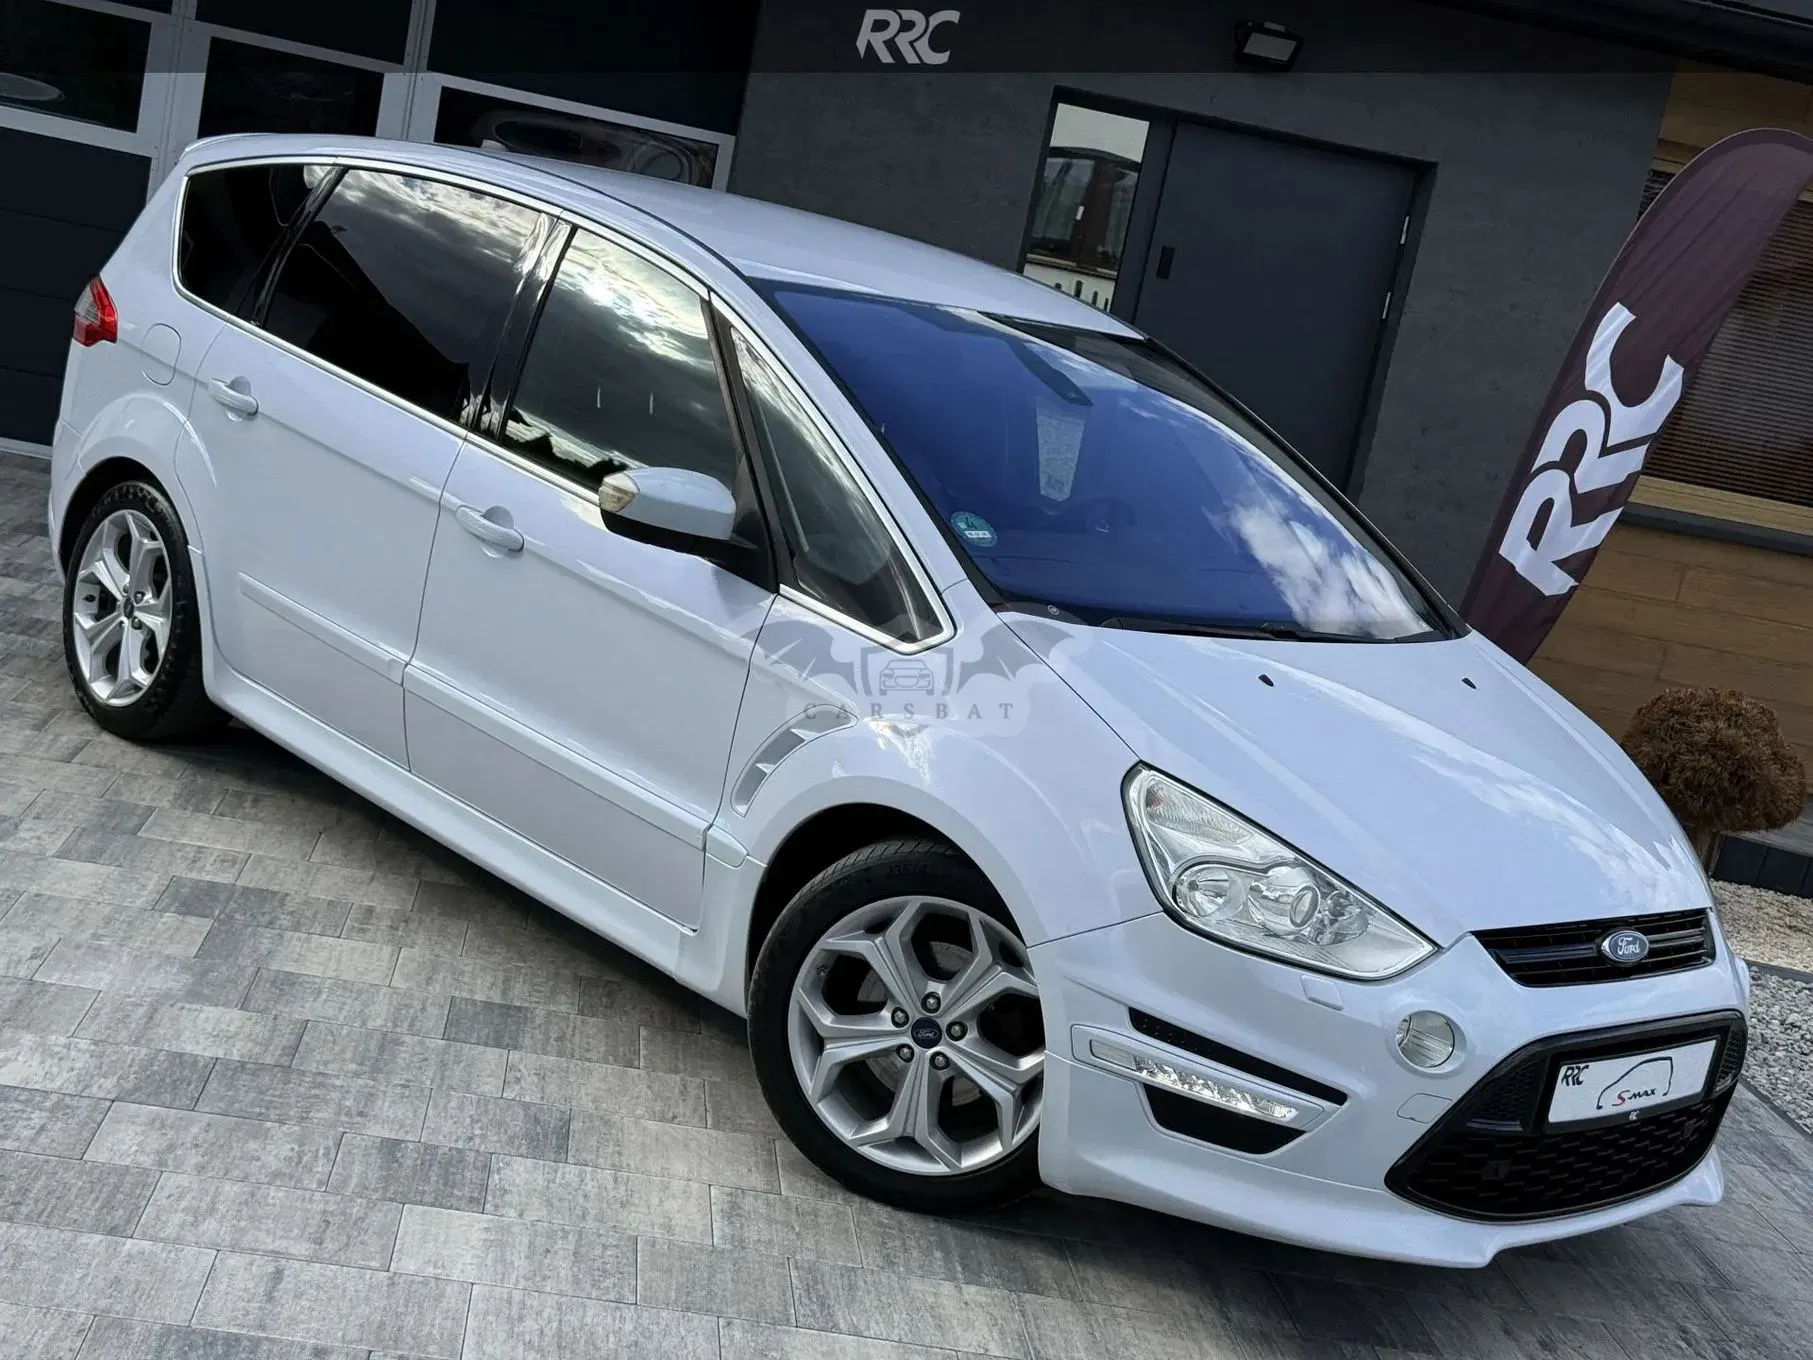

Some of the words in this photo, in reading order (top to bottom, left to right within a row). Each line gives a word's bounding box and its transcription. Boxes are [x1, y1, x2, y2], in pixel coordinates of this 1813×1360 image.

[1499, 301, 1684, 596] RRC
[1617, 936, 1641, 955] Ford
[1561, 1064, 1590, 1087] RRC
